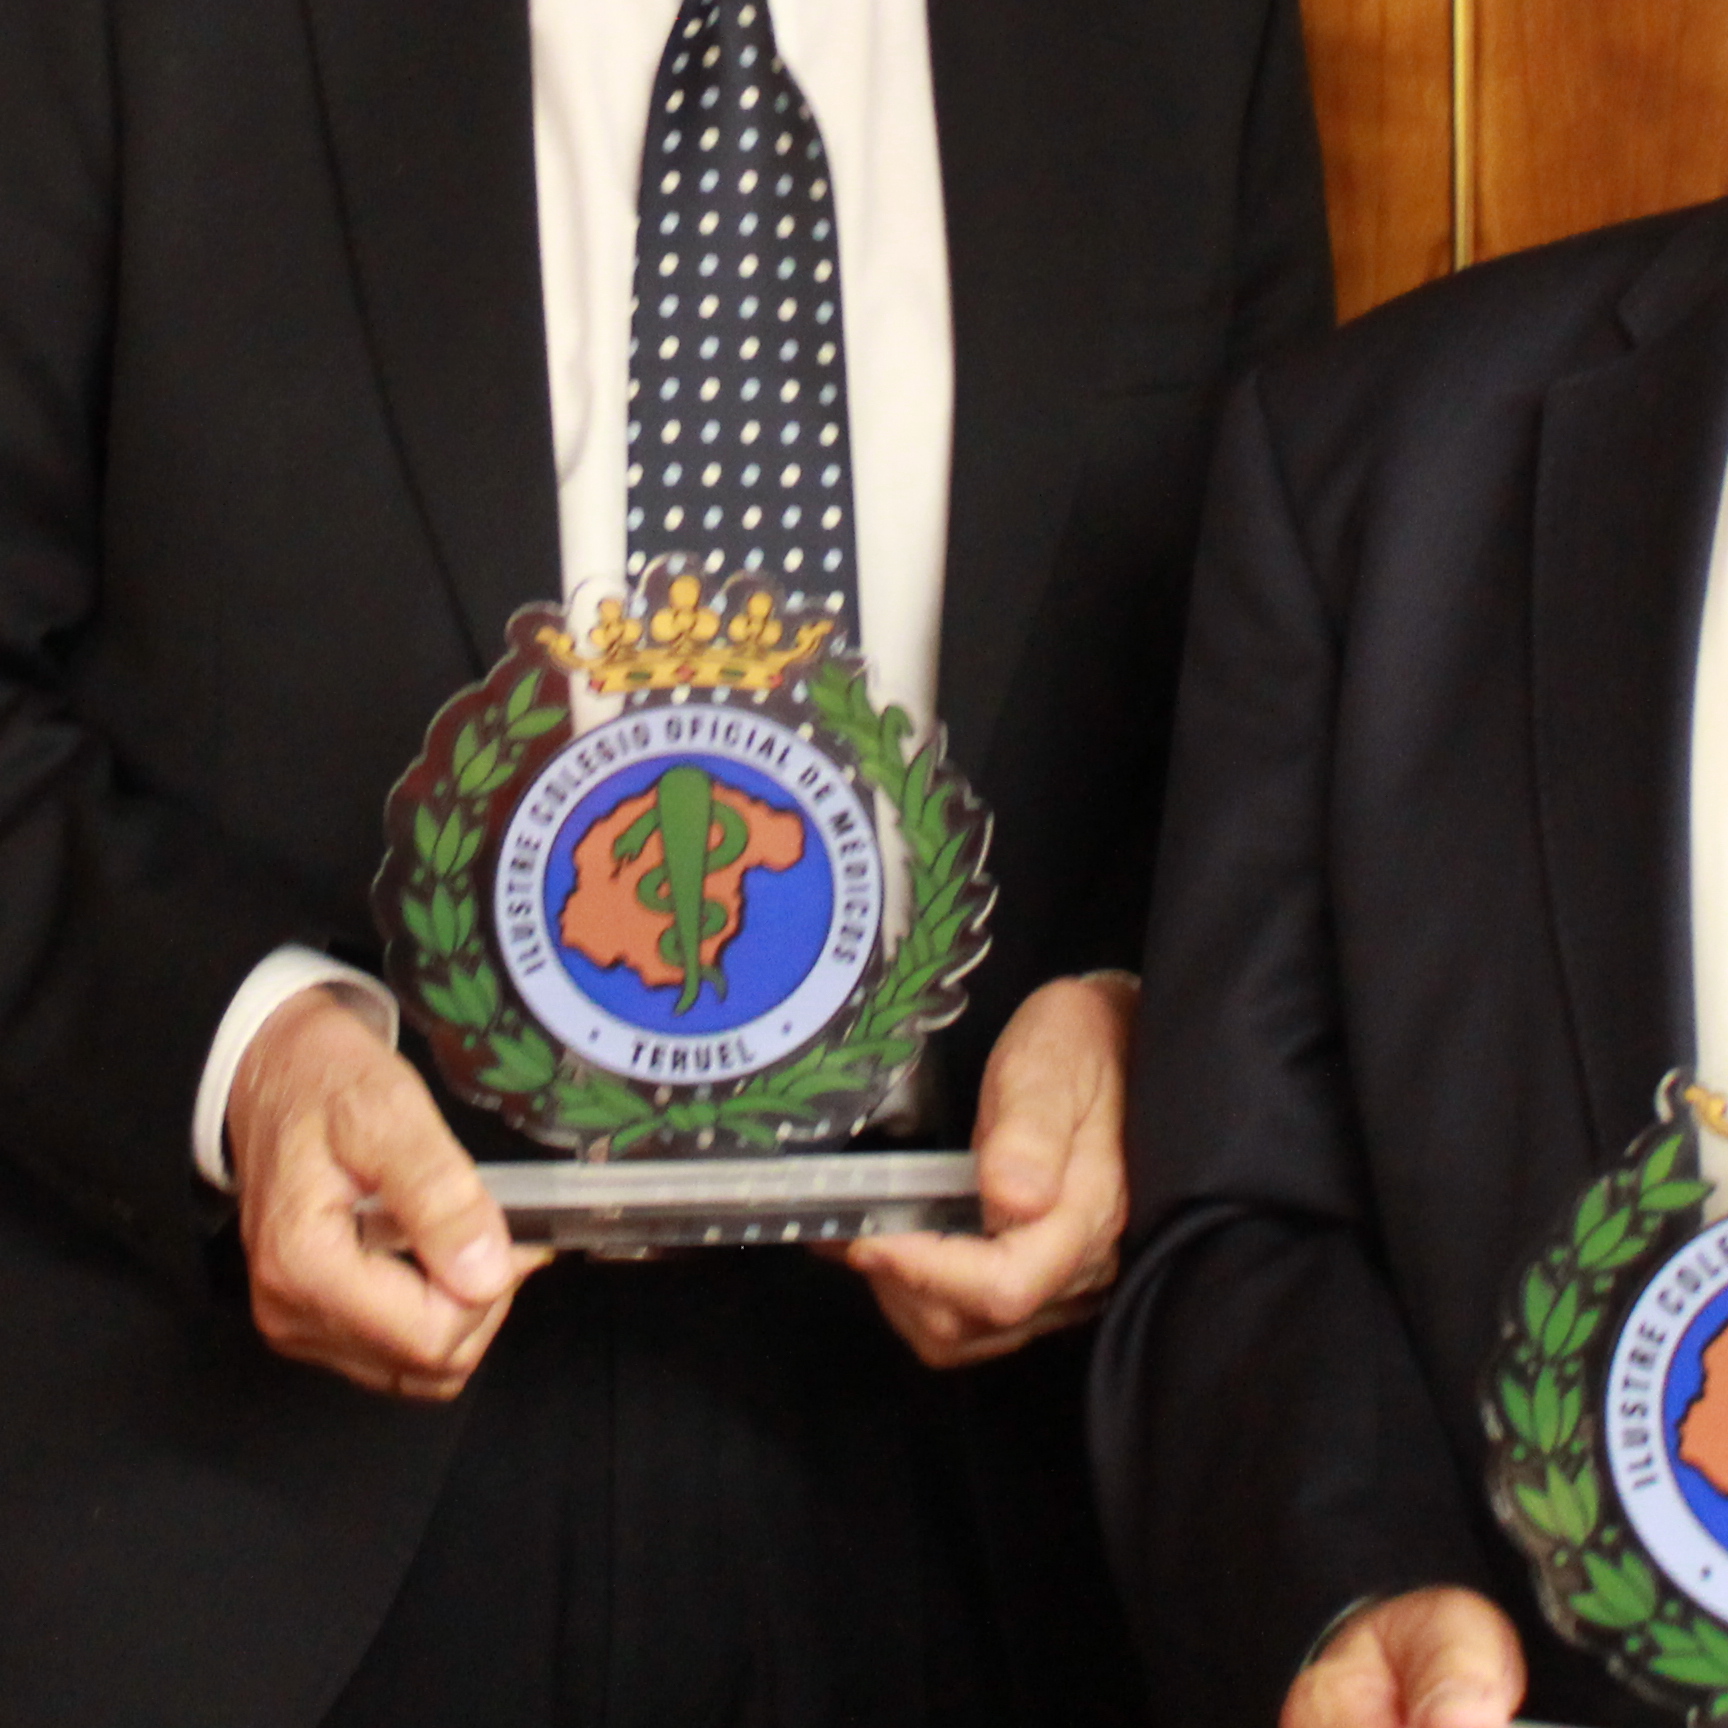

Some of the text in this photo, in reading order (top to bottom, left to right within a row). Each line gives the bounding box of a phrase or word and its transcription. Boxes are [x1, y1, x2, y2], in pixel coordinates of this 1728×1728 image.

[506, 832, 547, 976] ILUSTRE
[529, 722, 651, 826] COLEGIO
[666, 716, 792, 768] OFICIAL
[798, 764, 833, 804] DE
[631, 1035, 755, 1071] TERUEL
[1619, 1321, 1668, 1490] ILUSTRE
